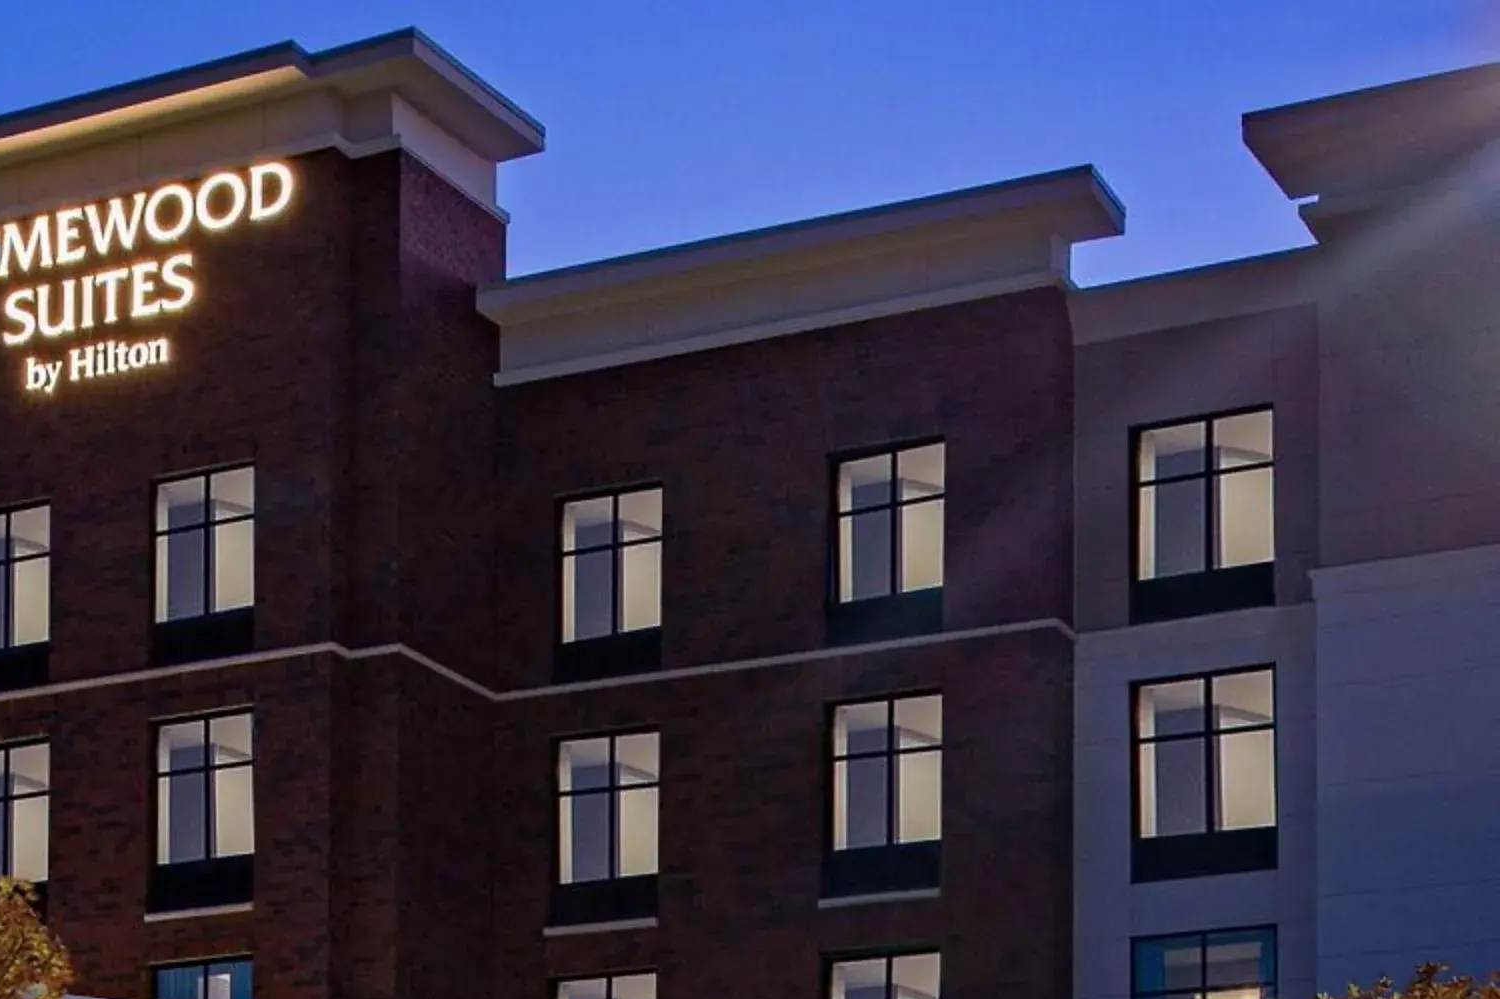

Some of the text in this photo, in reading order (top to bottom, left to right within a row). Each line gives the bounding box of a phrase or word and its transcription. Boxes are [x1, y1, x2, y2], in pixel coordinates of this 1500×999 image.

[1, 253, 197, 346] SUITES
[25, 337, 170, 393] by Hilton
